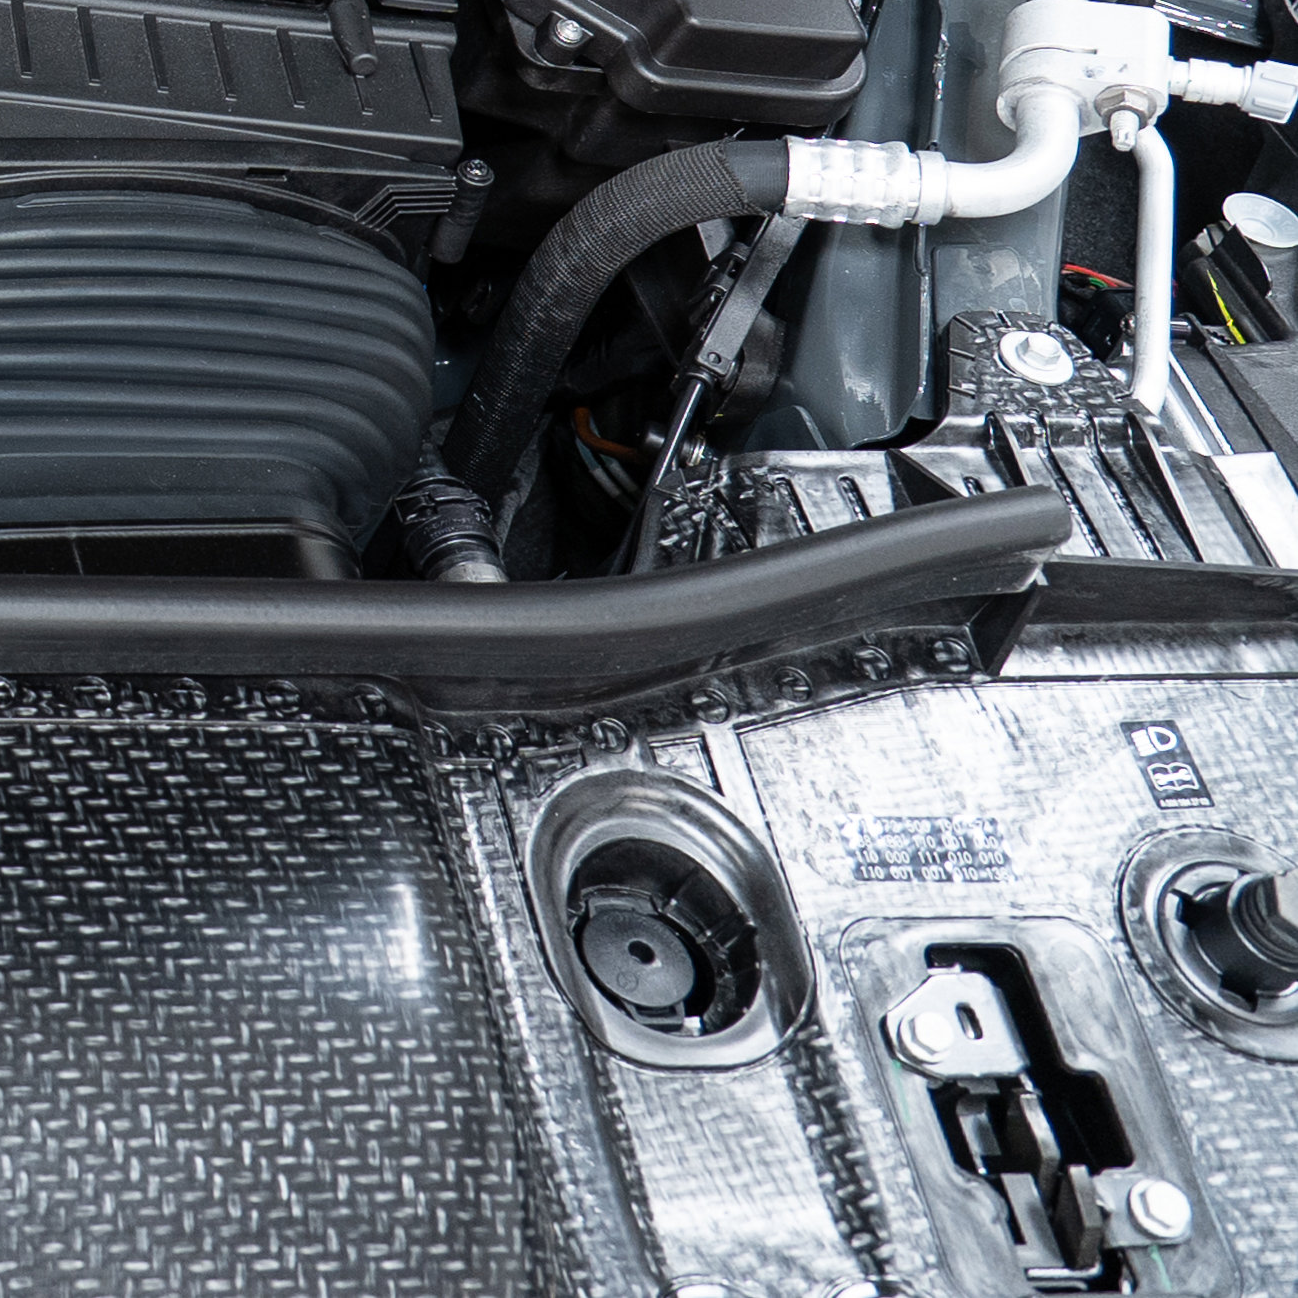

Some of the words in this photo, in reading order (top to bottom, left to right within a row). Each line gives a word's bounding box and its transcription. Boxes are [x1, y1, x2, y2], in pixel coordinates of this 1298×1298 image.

[856, 850, 879, 864] 110
[885, 850, 910, 864] 000
[918, 850, 940, 864] 111
[947, 851, 972, 865] 010
[978, 851, 1004, 865] 010
[860, 866, 885, 880] 110
